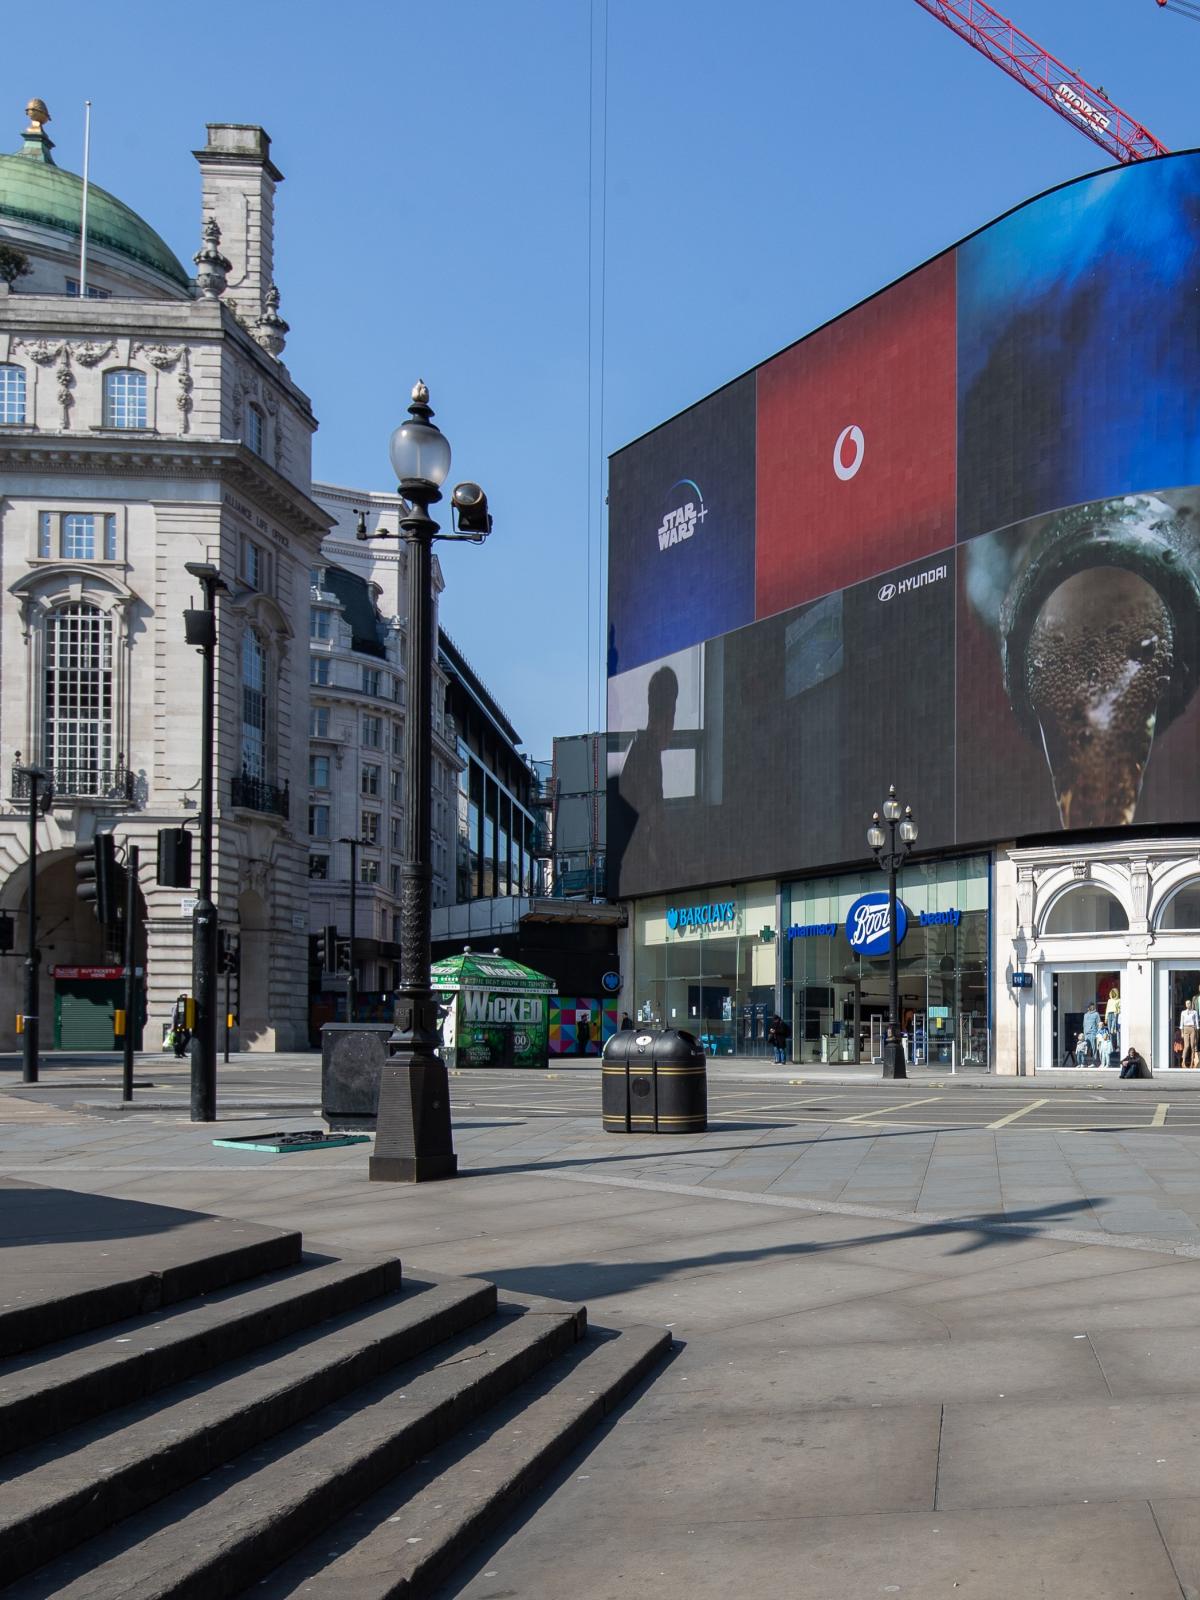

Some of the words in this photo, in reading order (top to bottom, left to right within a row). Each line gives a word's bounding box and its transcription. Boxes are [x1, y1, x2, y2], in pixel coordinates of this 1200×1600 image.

[224, 492, 252, 521] ALLIANCE
[255, 515, 268, 533] LIFE
[658, 502, 697, 535] STAR
[658, 518, 697, 551] WARS
[898, 565, 947, 595] HYUNDAI
[679, 902, 735, 925] BARCLAYS
[919, 907, 962, 928] beauty
[787, 922, 839, 941] pharmacy
